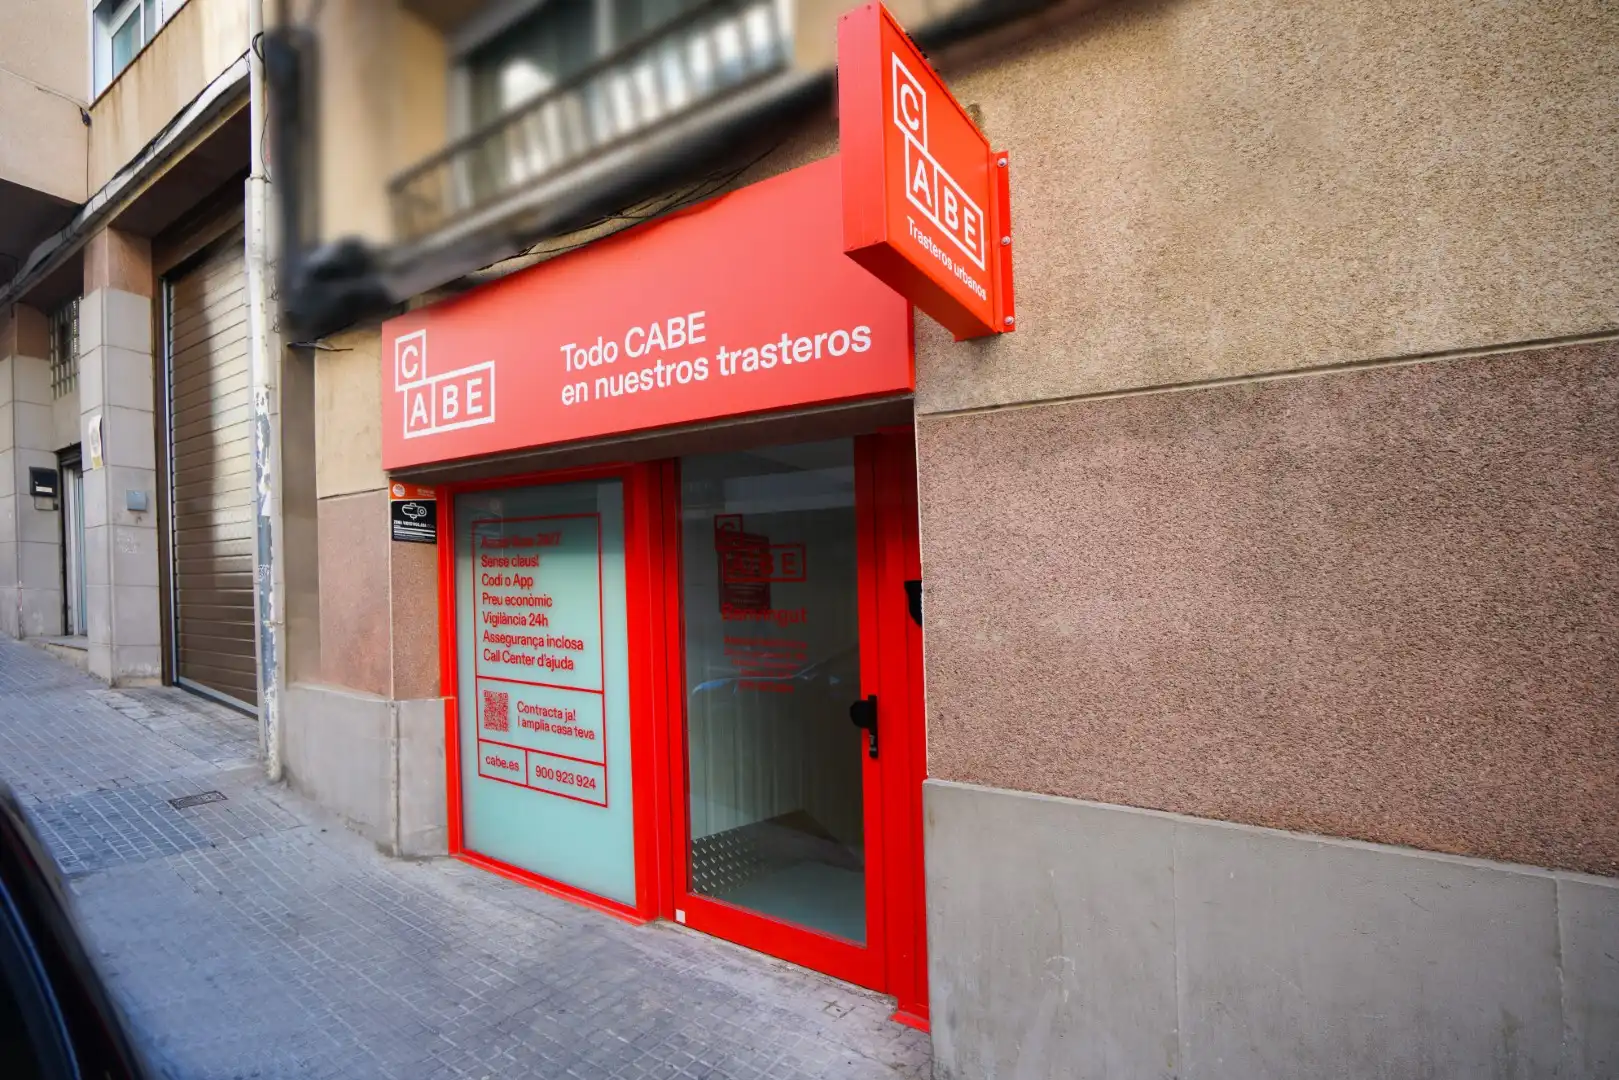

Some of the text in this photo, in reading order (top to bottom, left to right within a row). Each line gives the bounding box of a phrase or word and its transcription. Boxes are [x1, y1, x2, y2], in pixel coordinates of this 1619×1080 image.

[900, 83, 919, 131] C
[907, 215, 988, 301] Trasteros urbanos
[560, 311, 706, 373] Todo CABE
[401, 344, 419, 379] C
[561, 324, 872, 406] en nuestros trasteros
[481, 554, 540, 568] Sense claus!
[481, 573, 534, 590] Codi o App
[482, 592, 553, 608] Preu econòmic
[482, 611, 549, 628] Vigilància 24h
[721, 602, 808, 628] Benvingut
[483, 630, 584, 651] Assegurança inclosa
[483, 648, 574, 672] Call Center d'ajuda
[517, 701, 576, 723] Contracta ja!
[521, 718, 550, 733] amplia
[551, 723, 573, 736] casa
[574, 727, 595, 740] teva
[485, 754, 520, 772] cabe.es
[535, 765, 597, 790] 900 923 924
